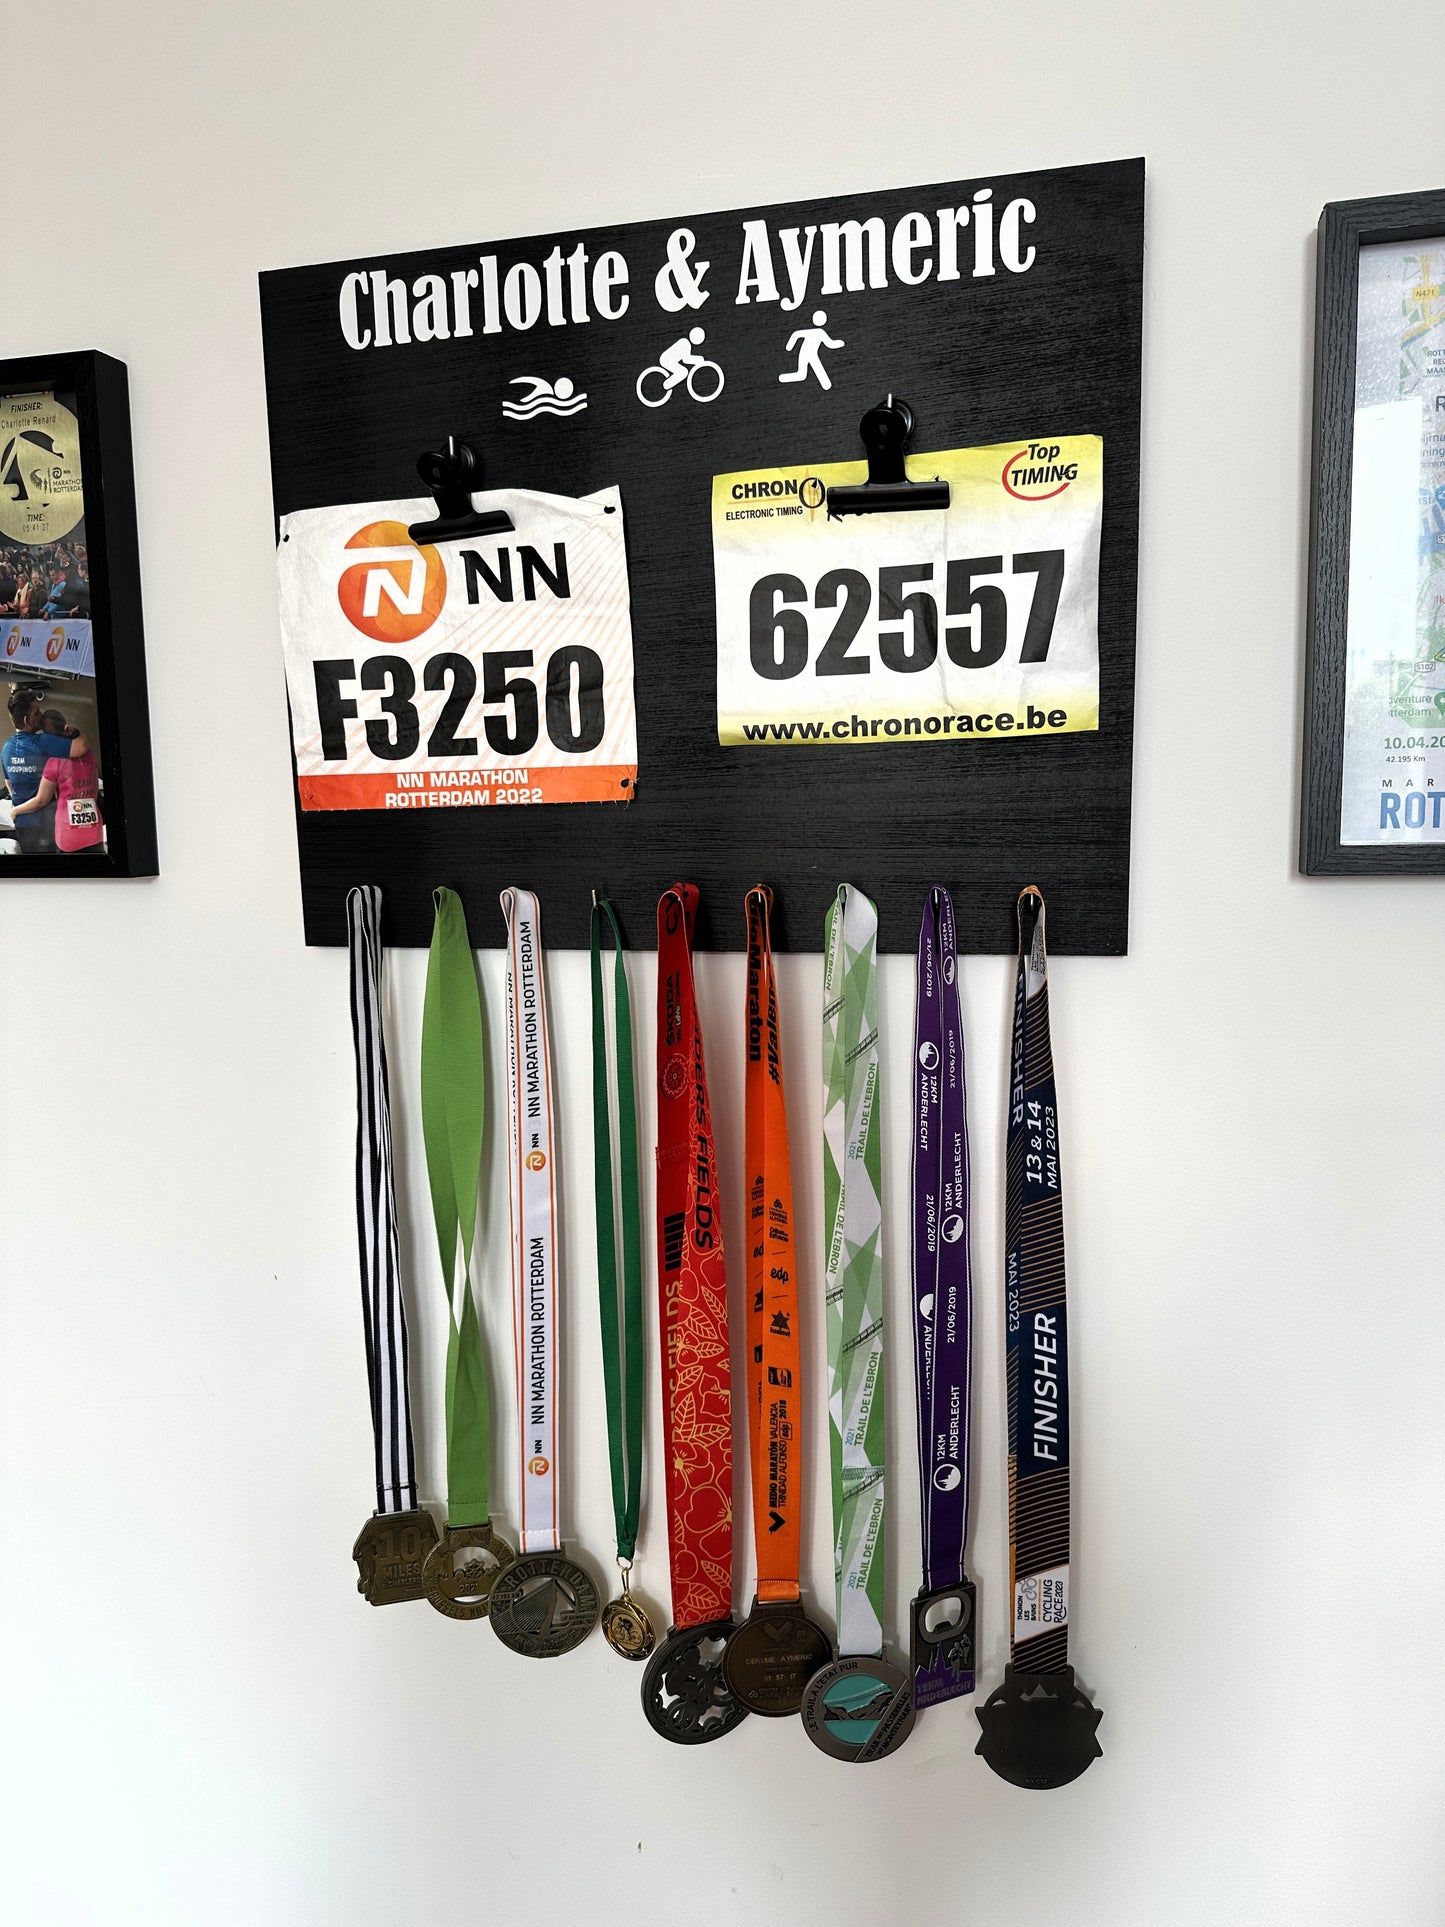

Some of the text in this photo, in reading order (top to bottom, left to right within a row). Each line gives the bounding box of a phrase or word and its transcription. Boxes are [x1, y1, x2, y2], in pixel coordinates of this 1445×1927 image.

[339, 188, 1036, 350] Charlotte & Aymeric
[1, 415, 56, 429] Charlotte Renard
[11, 402, 43, 413] FINISHER:
[1011, 443, 1078, 487] Top TIMING
[27, 513, 45, 523] TIME:
[726, 506, 803, 521] ELECTRONIC TIMING
[459, 542, 571, 604] NN
[749, 549, 1064, 680] 62557
[313, 645, 605, 761] F3250
[743, 705, 1067, 740] www.chronorace.be
[385, 787, 543, 808] ROTTERDAM 2022
[397, 768, 528, 788] NN MARATHON
[71, 812, 96, 824] F3250
[520, 921, 541, 1117] NN MARATHON ROTTERDAM
[861, 1110, 870, 1126] DE
[920, 1073, 928, 1151] ANDERLECHT
[930, 1075, 938, 1103] 12KM
[856, 1130, 868, 1160] TRAIL
[954, 1132, 963, 1209] ANDERLECHT
[1026, 1100, 1042, 1184] 13 & 14
[1045, 1106, 1058, 1189] MAI 2023
[695, 1135, 713, 1249] FIELDS
[926, 1193, 936, 1252] 21/06/2019
[947, 1286, 957, 1343] 21/06/2019
[1007, 1252, 1020, 1332] MAI 2023
[530, 1237, 545, 1424] NN MARATHON ROTTERDAM
[854, 1352, 879, 1447] TRAIL DE L'EBRON
[1033, 1312, 1058, 1461] FINISHER
[770, 1403, 778, 1439] VALENCIA
[937, 1433, 946, 1461] 12KM
[949, 1385, 960, 1459] ANDERLECHT
[769, 1482, 777, 1508] MEDIO
[856, 1498, 883, 1590] TRAIL DE L'EBRON
[504, 1559, 595, 1612] ROTTERDAM
[1043, 1579, 1053, 1622] CYCLING
[807, 1698, 816, 1721] TRAIL
[839, 1661, 858, 1673] PUR
